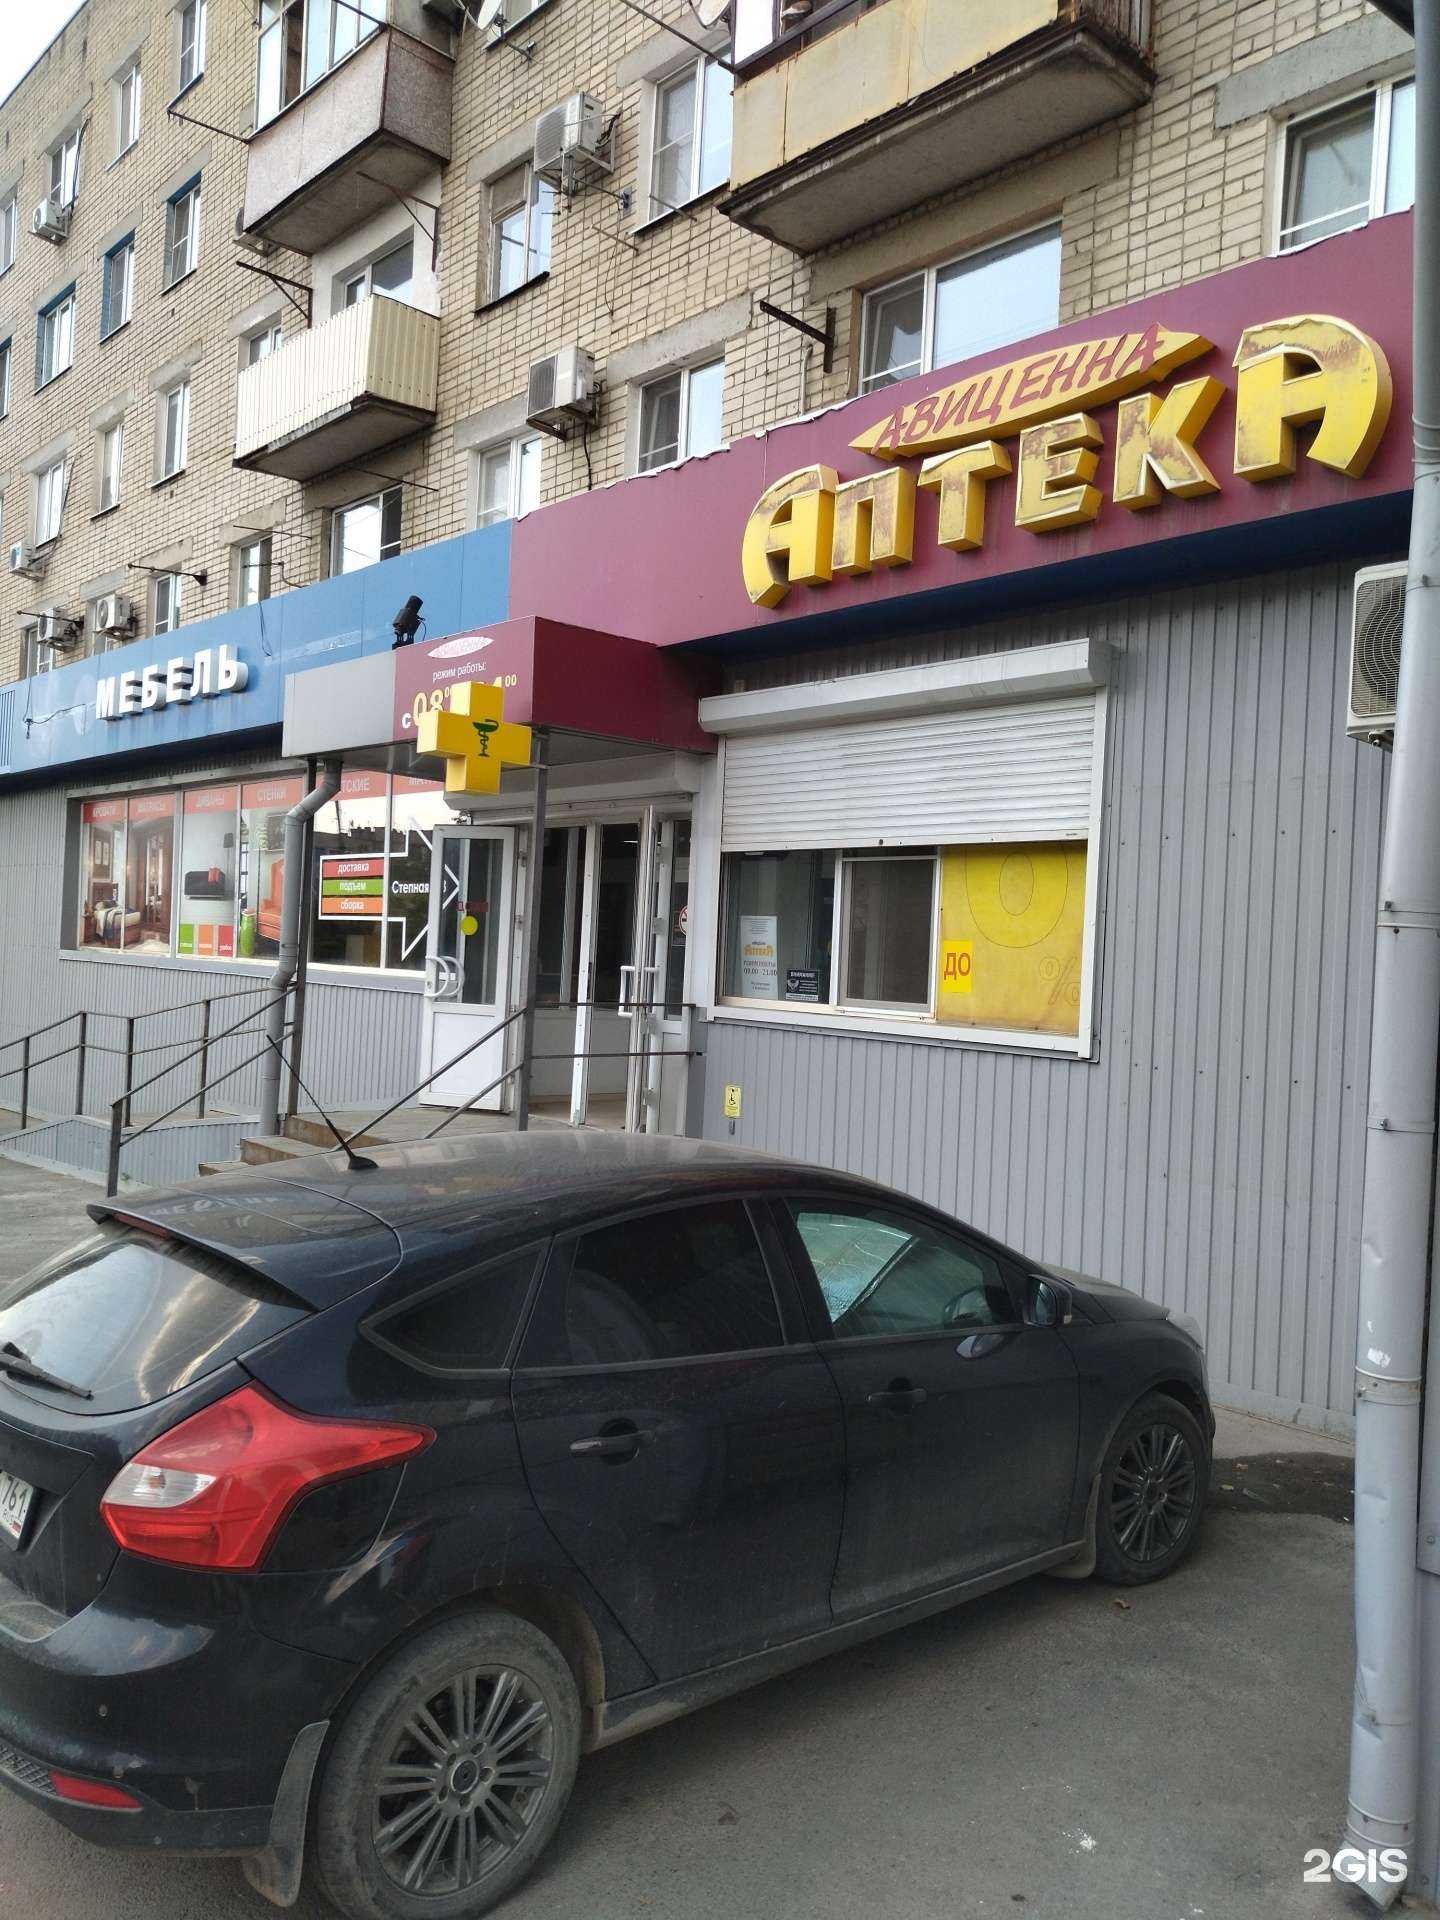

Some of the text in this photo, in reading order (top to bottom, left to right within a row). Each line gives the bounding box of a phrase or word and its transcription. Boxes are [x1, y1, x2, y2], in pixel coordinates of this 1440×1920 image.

[870, 323, 1164, 454] АВИЦЕННА
[741, 314, 1393, 608] АПТЕКА
[96, 644, 249, 720] МЕБЕЛЬ
[432, 667, 456, 683] режим
[338, 863, 369, 875] доставка
[392, 881, 430, 894] Степная
[944, 953, 971, 980] ДО
